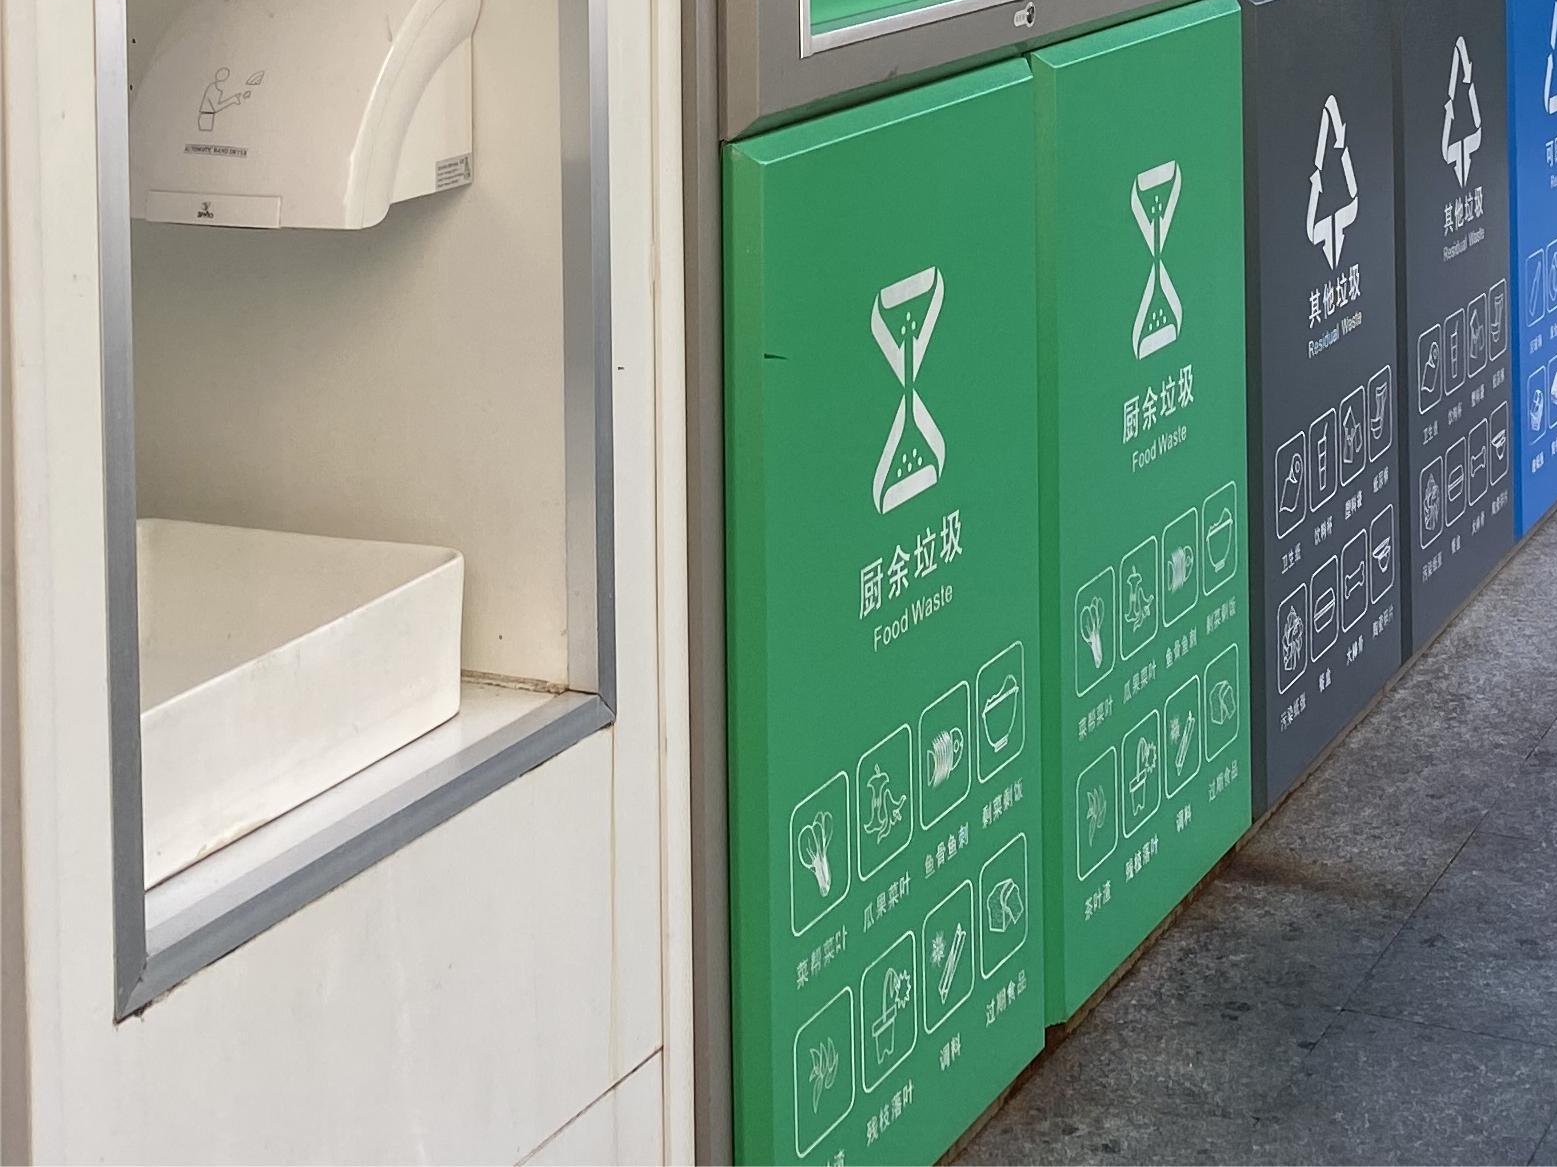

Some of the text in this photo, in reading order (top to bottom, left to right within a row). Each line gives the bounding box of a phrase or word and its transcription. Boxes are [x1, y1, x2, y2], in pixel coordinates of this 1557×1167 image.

[1444, 185, 1484, 237] 其他垃圾
[1308, 263, 1361, 329] 其他垃圾
[1122, 363, 1194, 444] 厨余垃圾
[1132, 425, 1188, 473] Food Waste
[860, 508, 963, 620] 厨余垃圾
[873, 584, 953, 652] Food Waste
[863, 871, 911, 933] 瓜果菜叶
[985, 969, 1027, 1029] 过期食品
